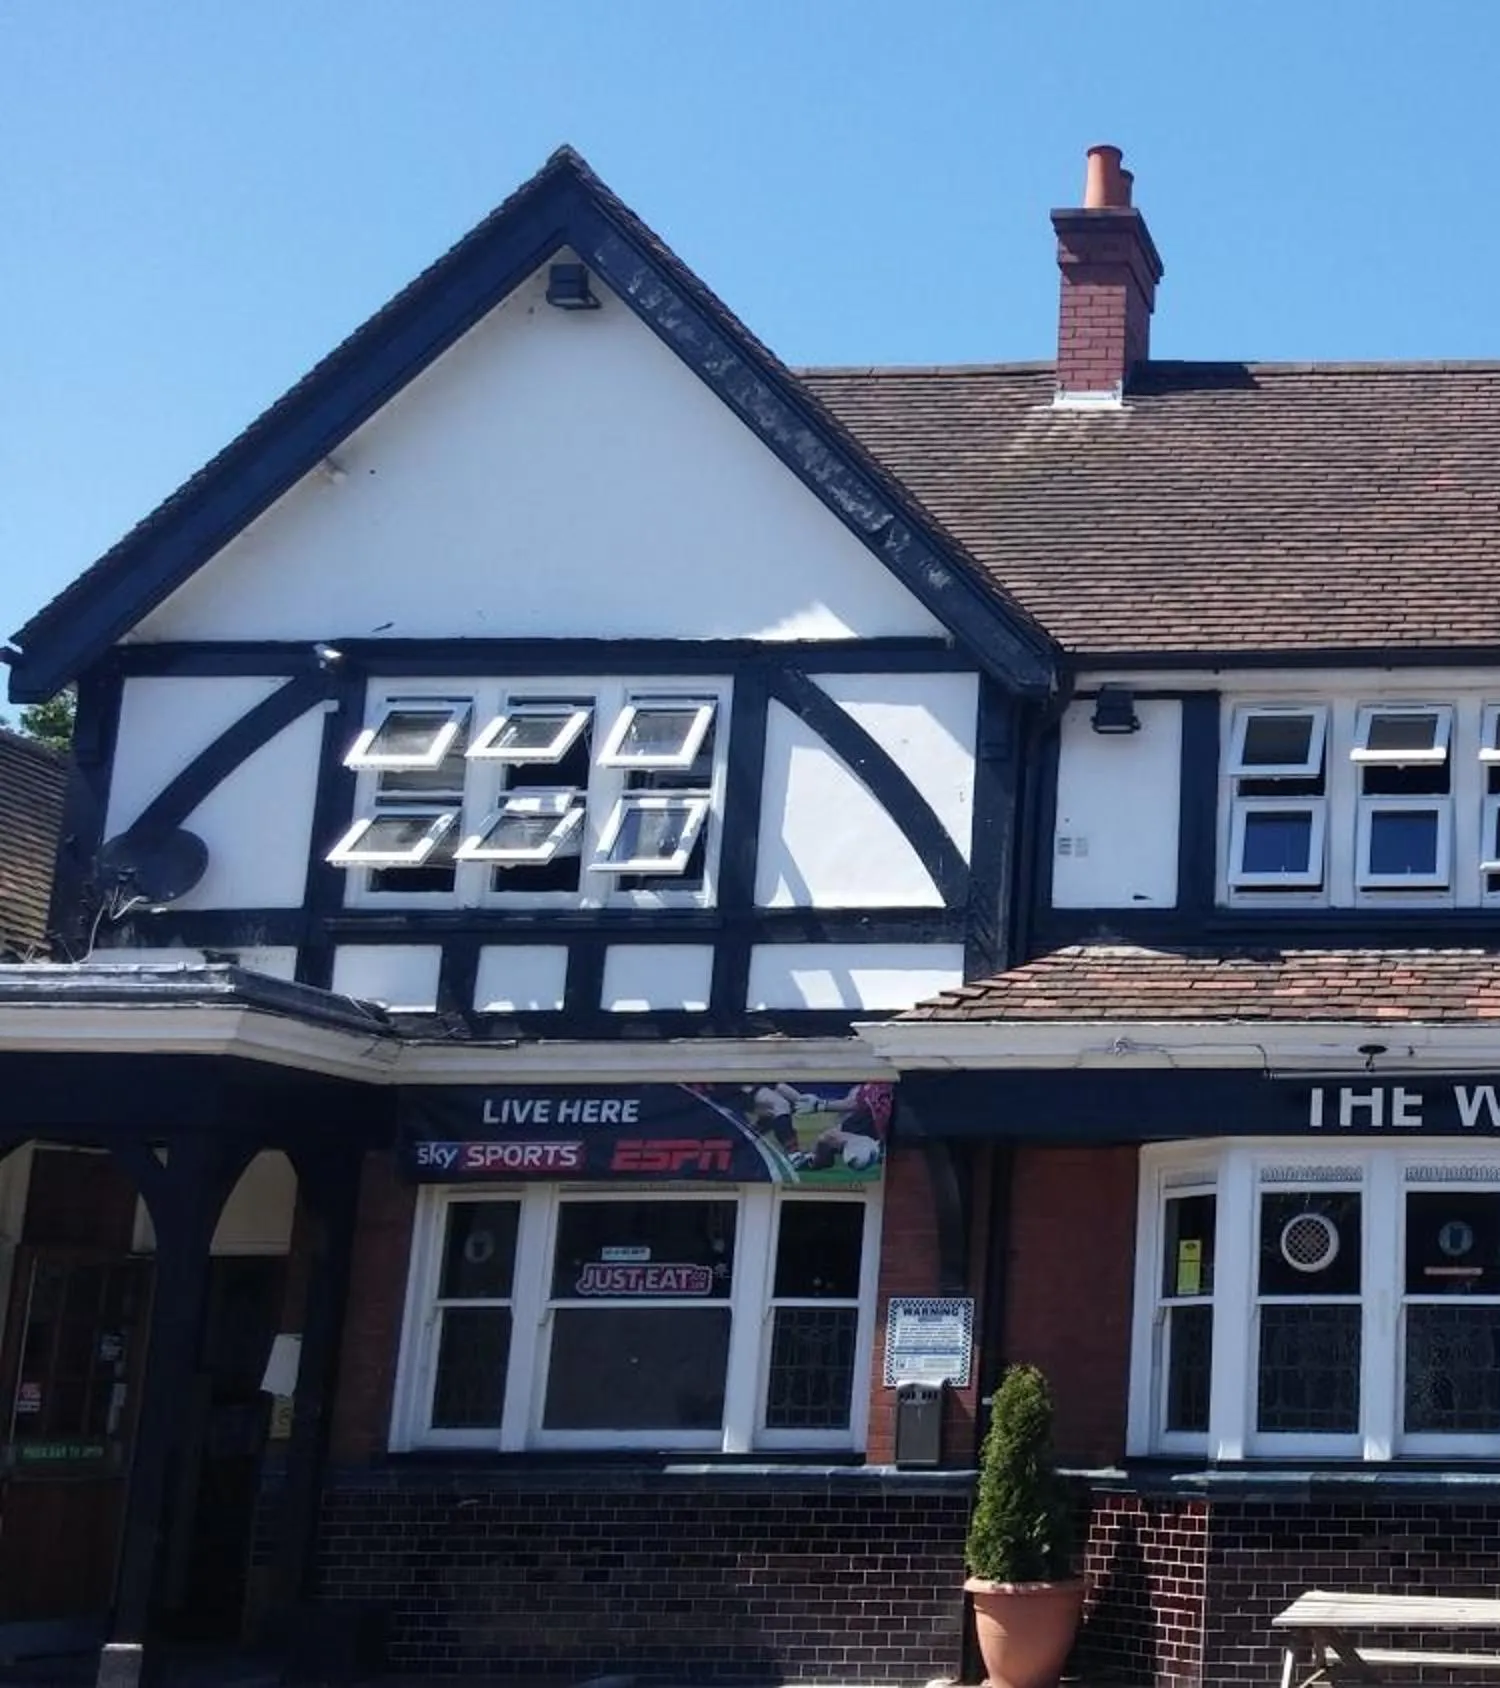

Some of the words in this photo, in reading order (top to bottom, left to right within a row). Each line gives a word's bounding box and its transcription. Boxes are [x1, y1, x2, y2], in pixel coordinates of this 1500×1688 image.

[483, 1100, 550, 1124] LIVE
[557, 1100, 639, 1123] HERE
[465, 1143, 578, 1167] SPORTS
[612, 1140, 732, 1170] ESPN
